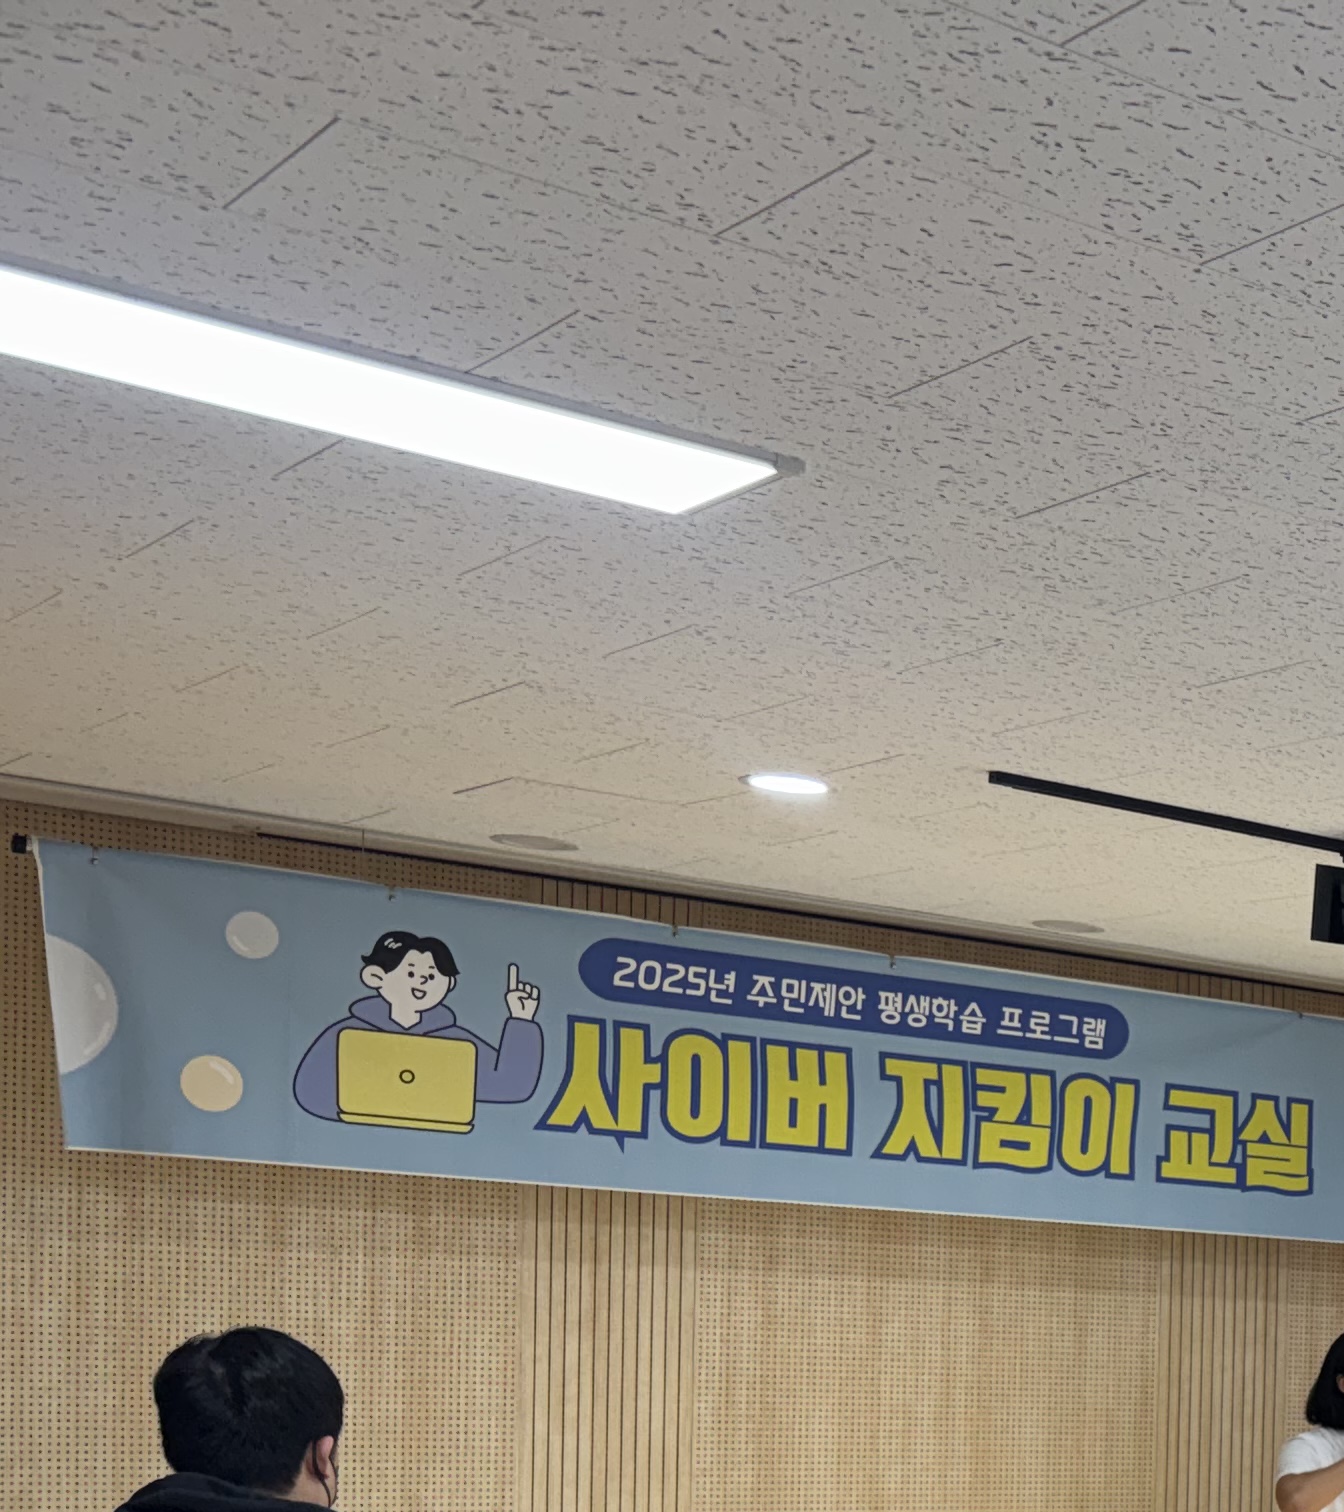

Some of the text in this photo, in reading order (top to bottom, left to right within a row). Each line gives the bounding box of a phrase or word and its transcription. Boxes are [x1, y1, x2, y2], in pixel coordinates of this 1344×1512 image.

[613, 956, 1106, 1050] 2025년 주민제안 평생학습 프로그램
[534, 1014, 1314, 1196] 사이버 지킴이 교실
